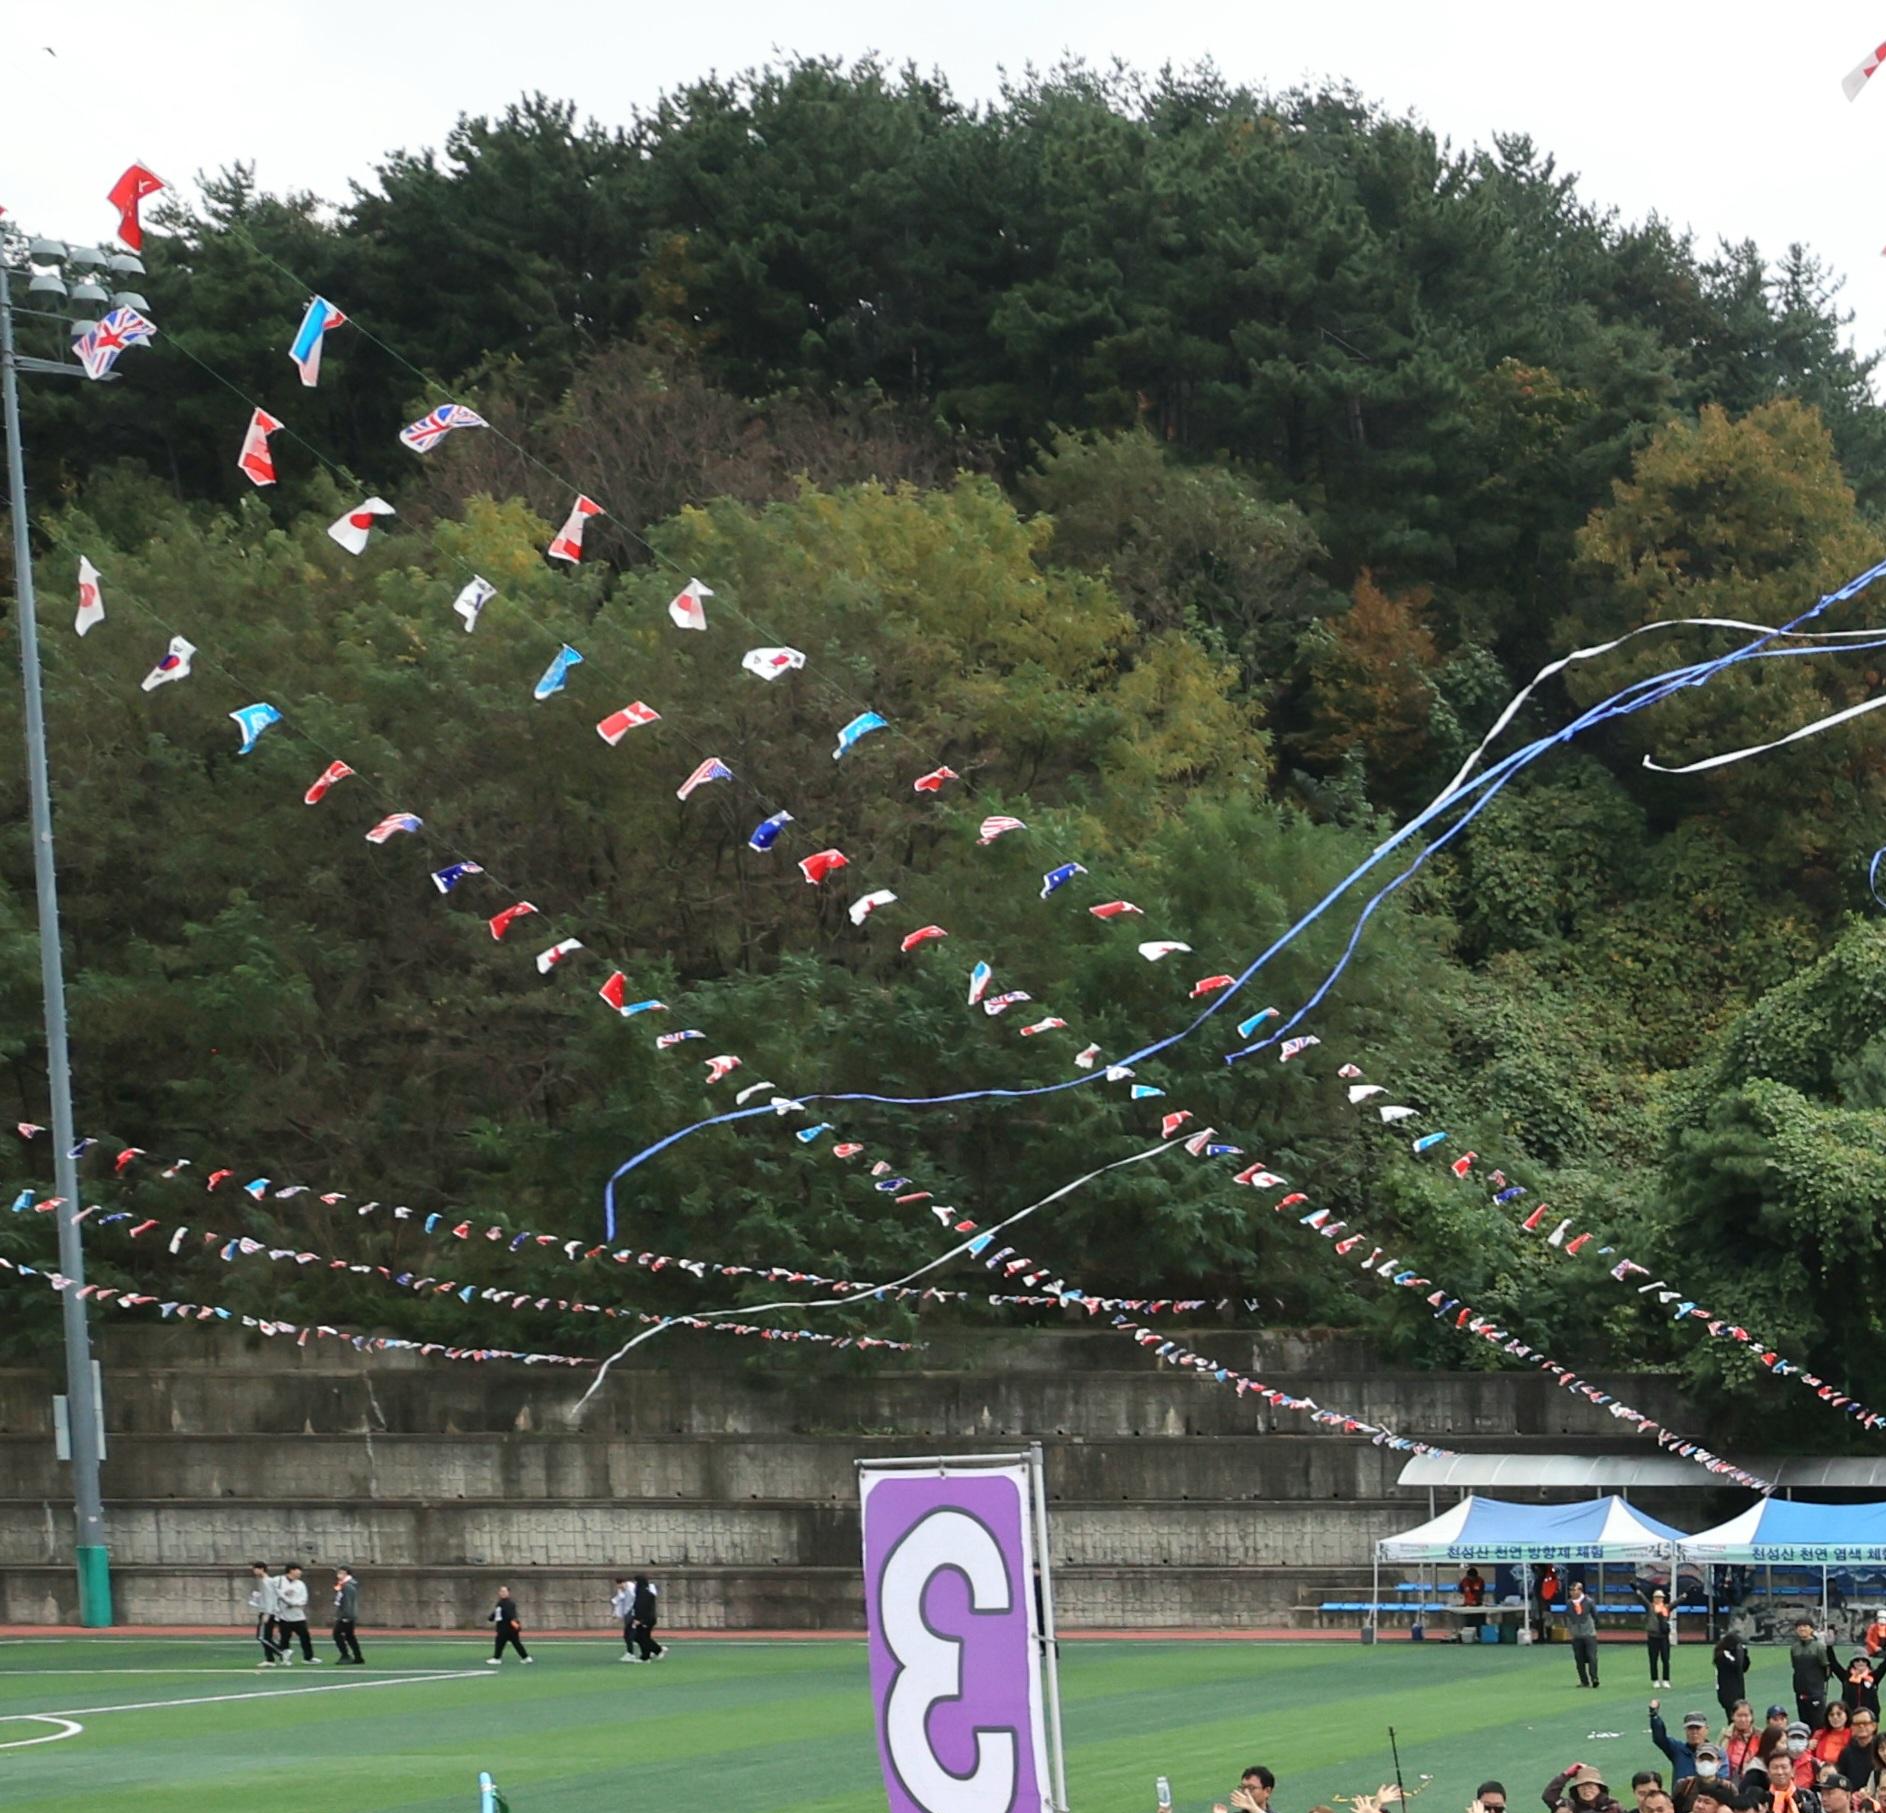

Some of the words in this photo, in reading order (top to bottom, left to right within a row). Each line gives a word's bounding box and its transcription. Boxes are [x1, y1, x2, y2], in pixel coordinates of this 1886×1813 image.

[1447, 1546, 1489, 1559] 천성산
[1495, 1546, 1522, 1559] 천연
[1528, 1546, 1572, 1559] 방향제
[1576, 1545, 1604, 1559] 체험
[1752, 1547, 1794, 1561] 천성산
[1800, 1547, 1828, 1561] 천연
[1834, 1547, 1862, 1561] 염색
